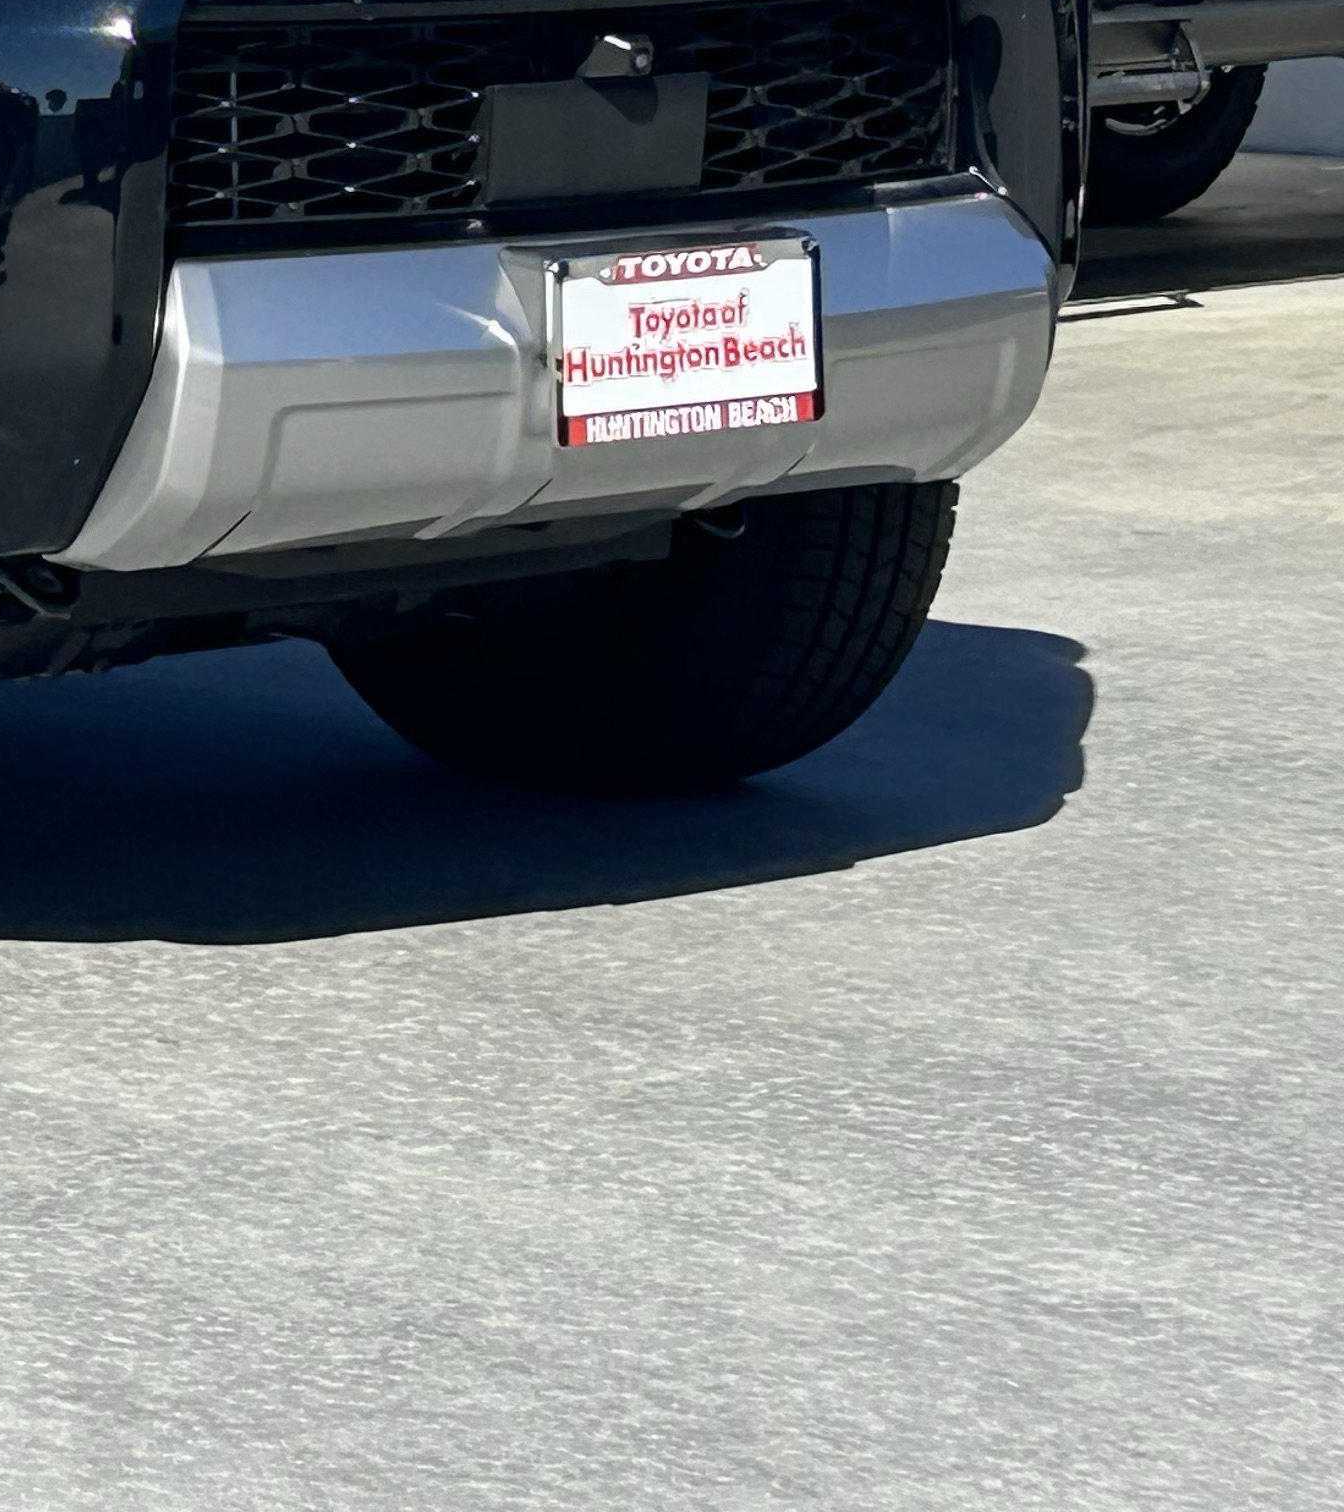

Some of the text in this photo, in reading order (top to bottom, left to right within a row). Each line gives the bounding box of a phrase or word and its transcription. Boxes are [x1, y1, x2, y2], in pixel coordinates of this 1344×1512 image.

[620, 247, 753, 279] TOYOTA
[629, 302, 718, 339] Toyota
[567, 326, 806, 382] Huntington Beach
[587, 396, 797, 443] HUNTINGTON BEACH
